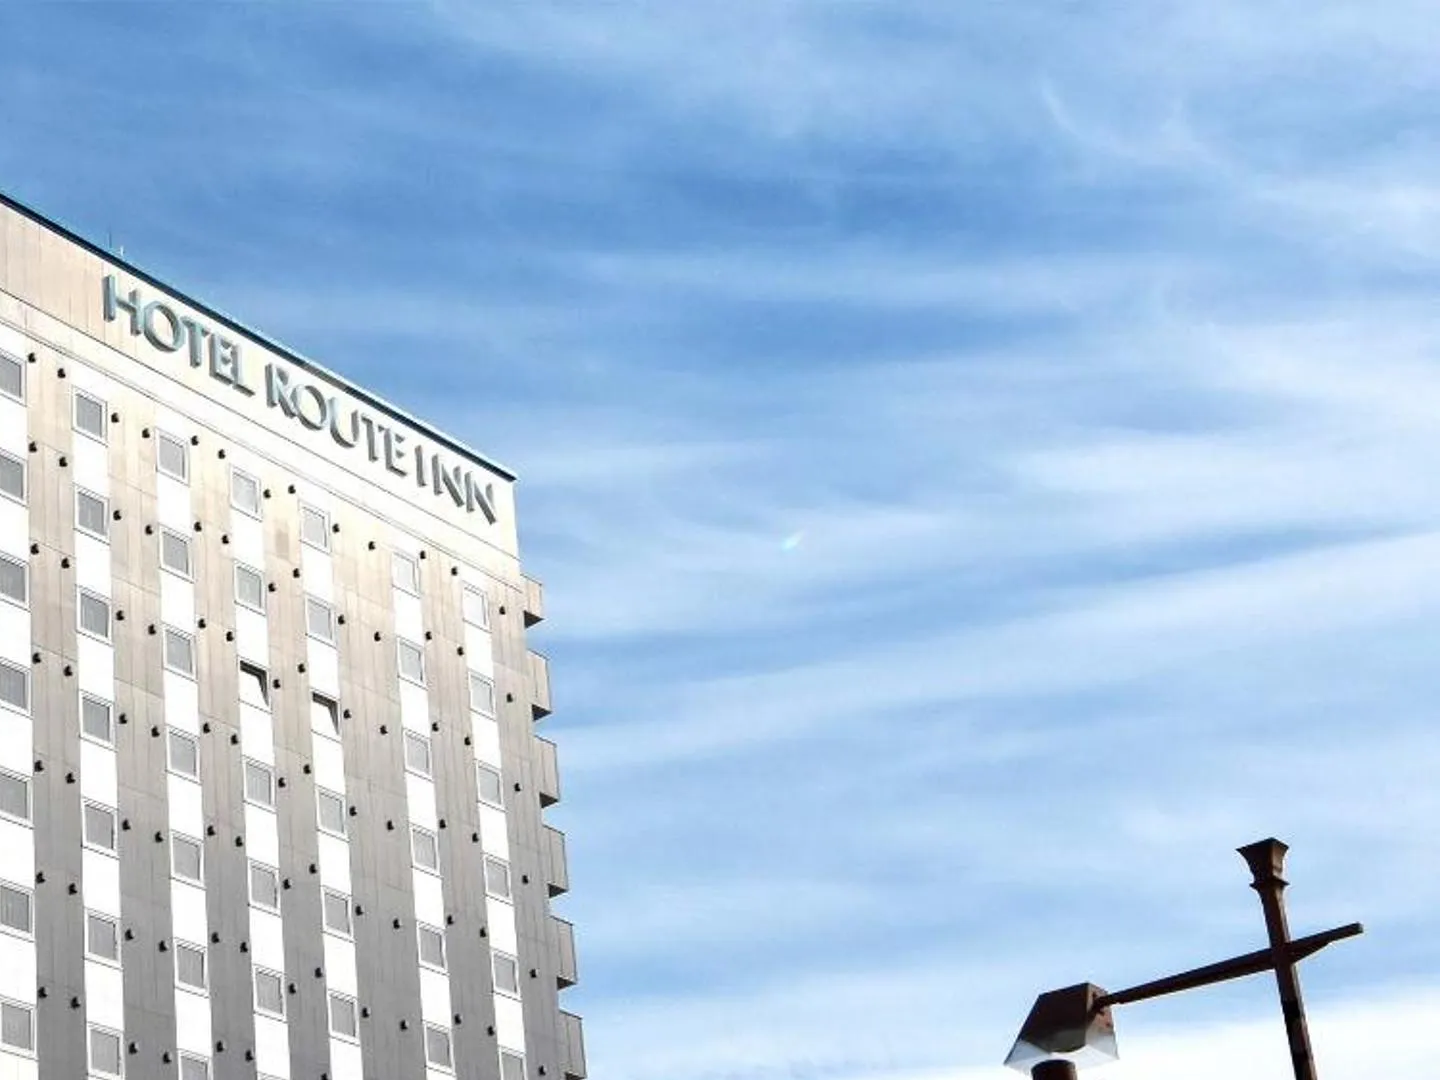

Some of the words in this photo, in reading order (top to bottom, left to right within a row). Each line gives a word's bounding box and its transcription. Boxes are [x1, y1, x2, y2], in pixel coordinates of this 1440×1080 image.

[102, 274, 256, 396] HOTEL
[265, 362, 407, 477] ROUTE
[415, 444, 497, 525] INN
